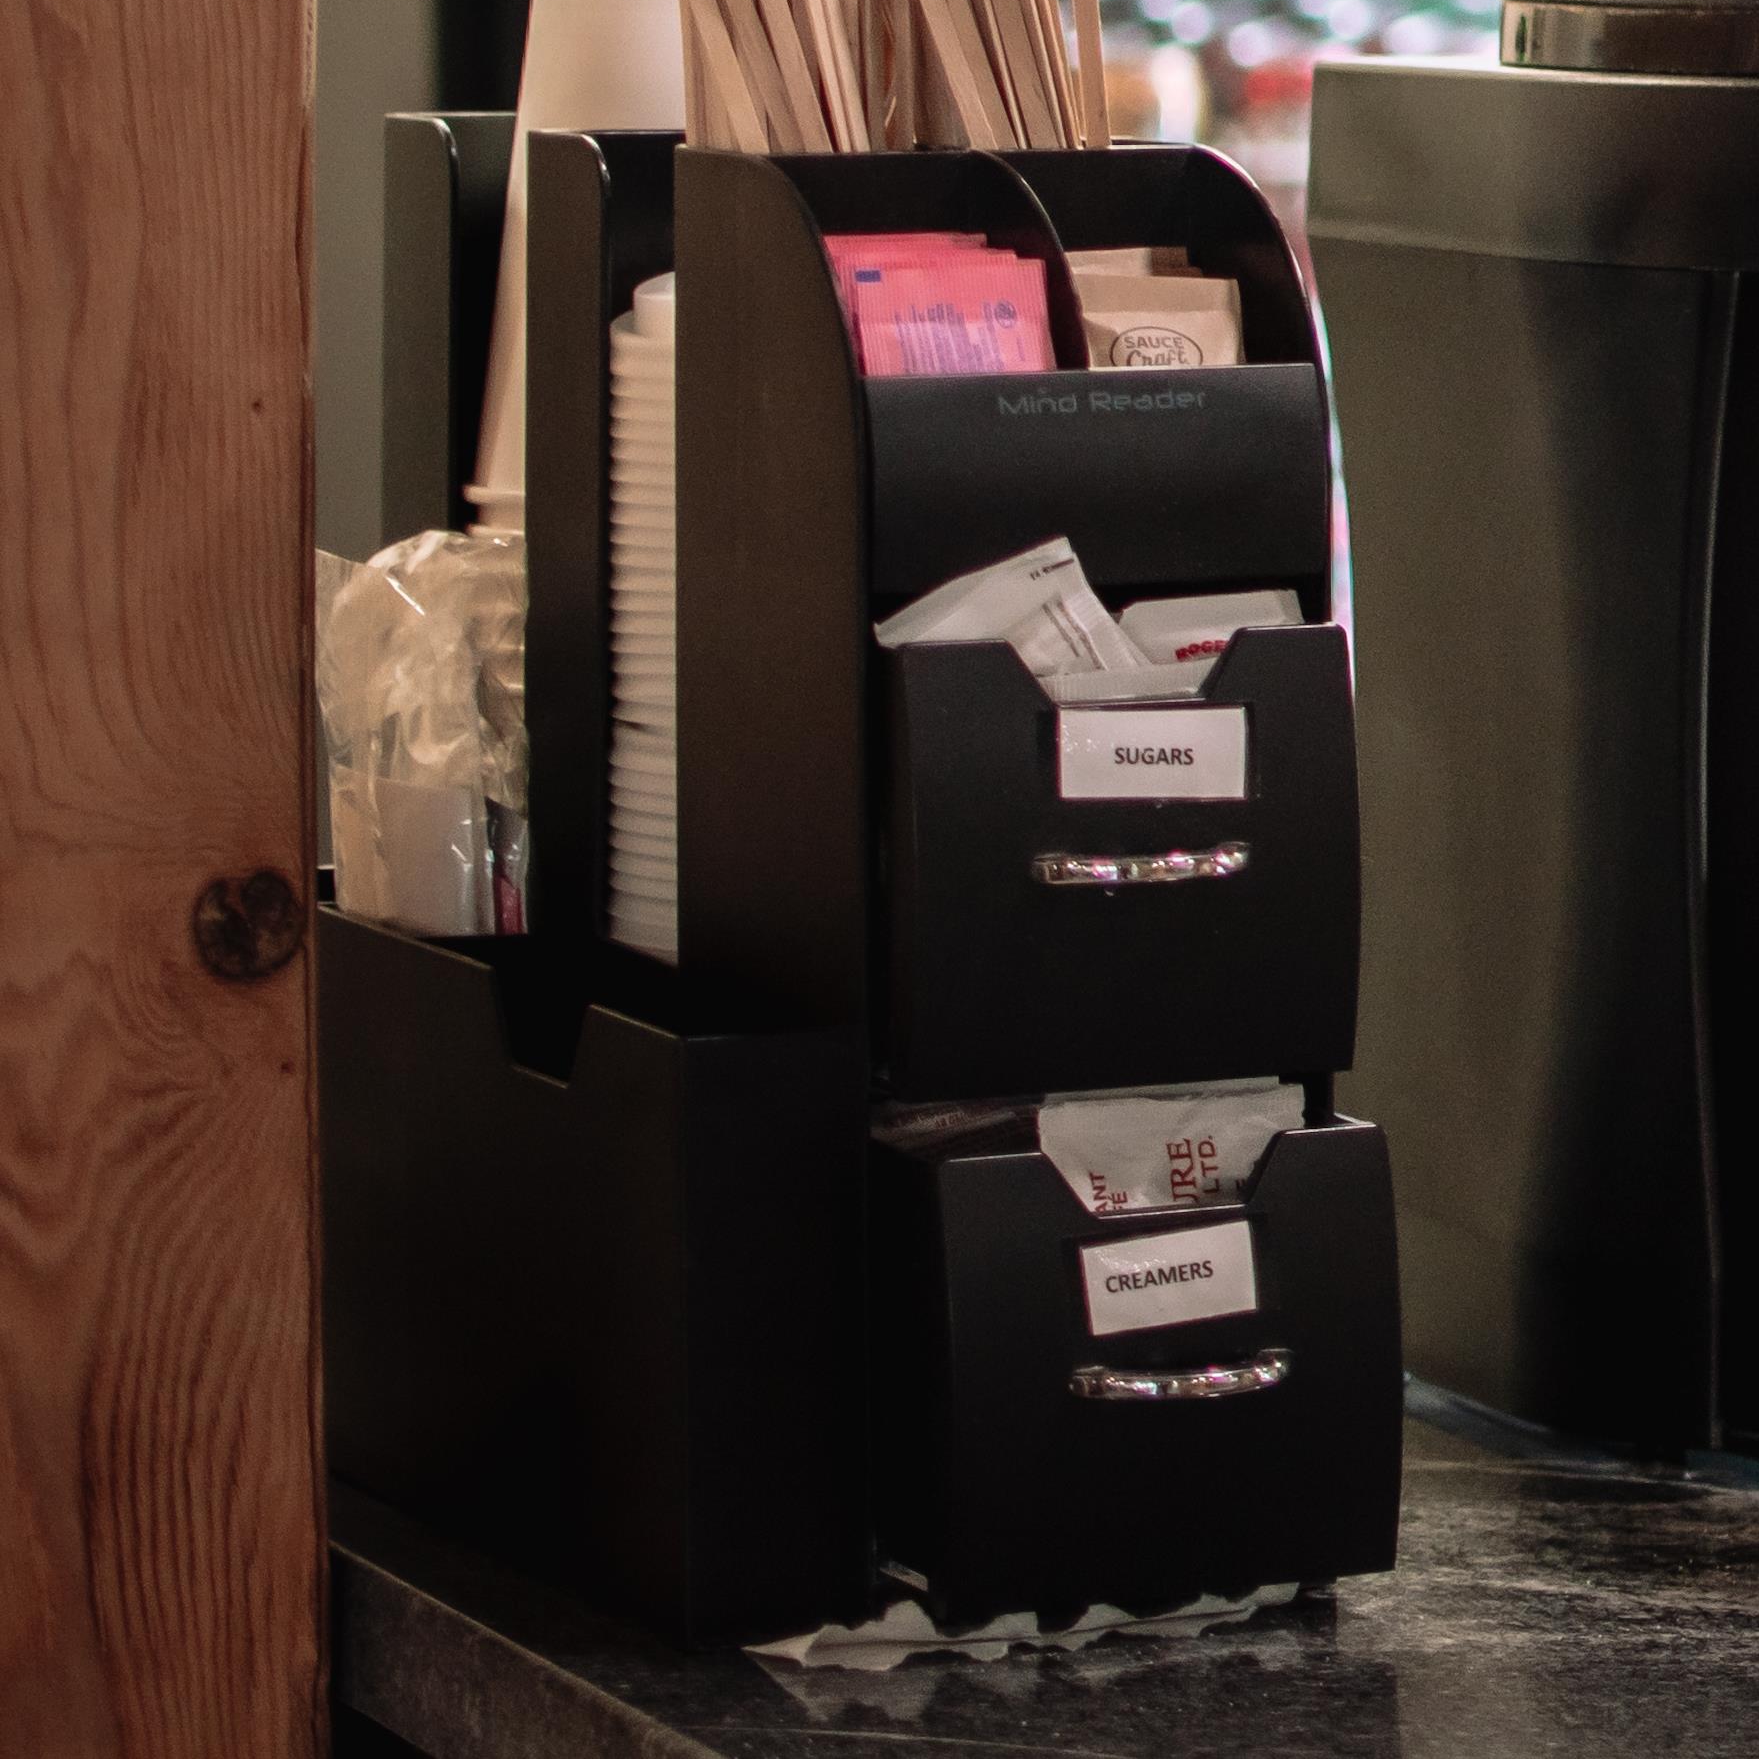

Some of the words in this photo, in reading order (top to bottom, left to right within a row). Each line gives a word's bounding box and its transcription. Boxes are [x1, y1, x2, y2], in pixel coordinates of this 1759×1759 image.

[1123, 335, 1186, 350] SAUCE
[998, 388, 1078, 415] Mind
[1089, 390, 1206, 413] Reader
[1174, 639, 1229, 662] ROGE
[1113, 747, 1195, 766] SUGARS
[1105, 1259, 1214, 1294] CREAMERS
